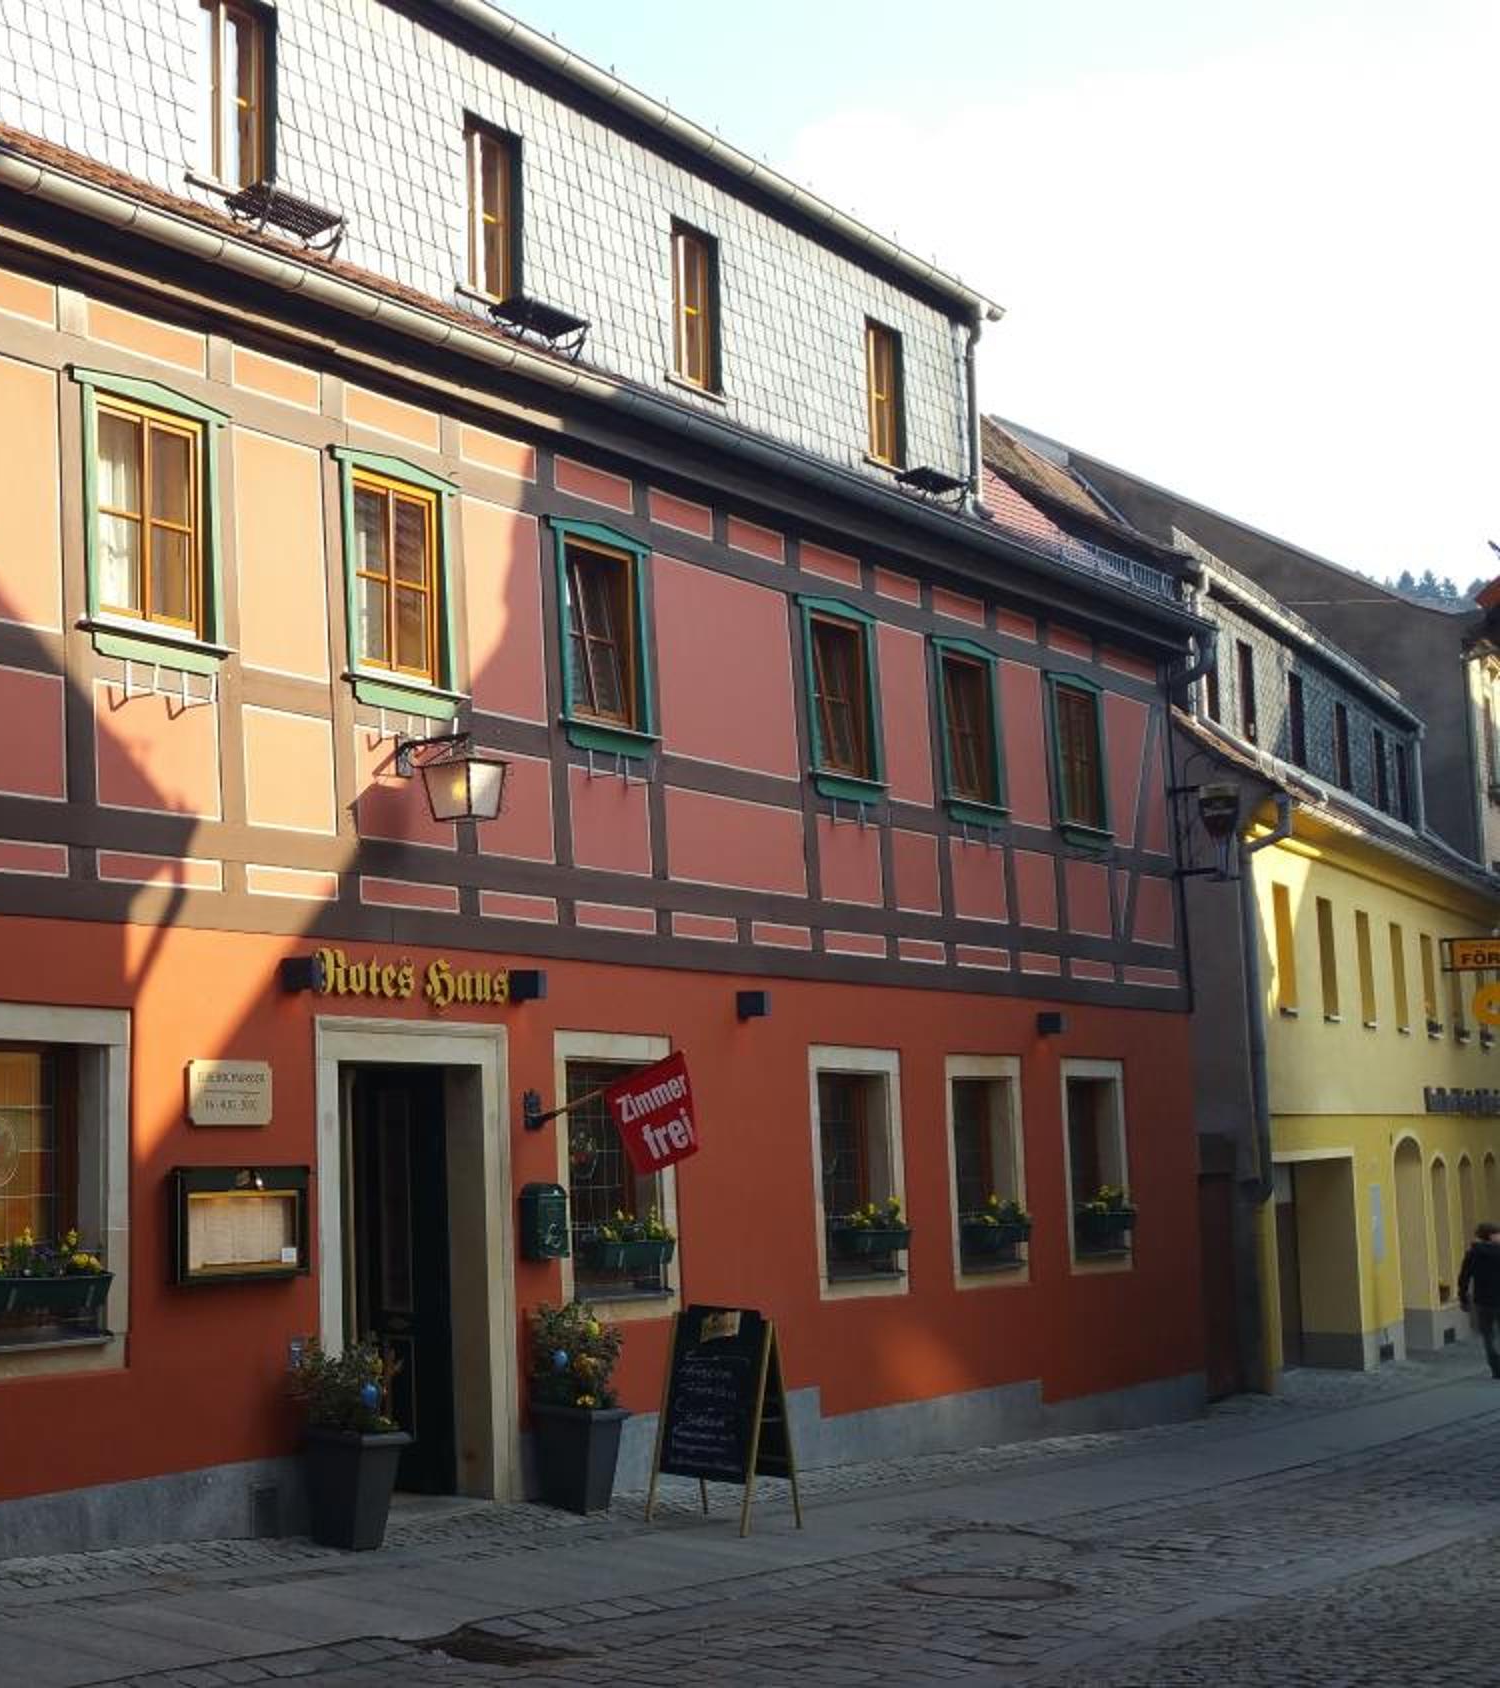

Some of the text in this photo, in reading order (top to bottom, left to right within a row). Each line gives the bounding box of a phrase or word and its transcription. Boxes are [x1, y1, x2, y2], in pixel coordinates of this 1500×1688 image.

[315, 947, 509, 1008] Rotes Haus
[616, 1075, 687, 1123] Zimmer
[642, 1107, 693, 1159] frei
